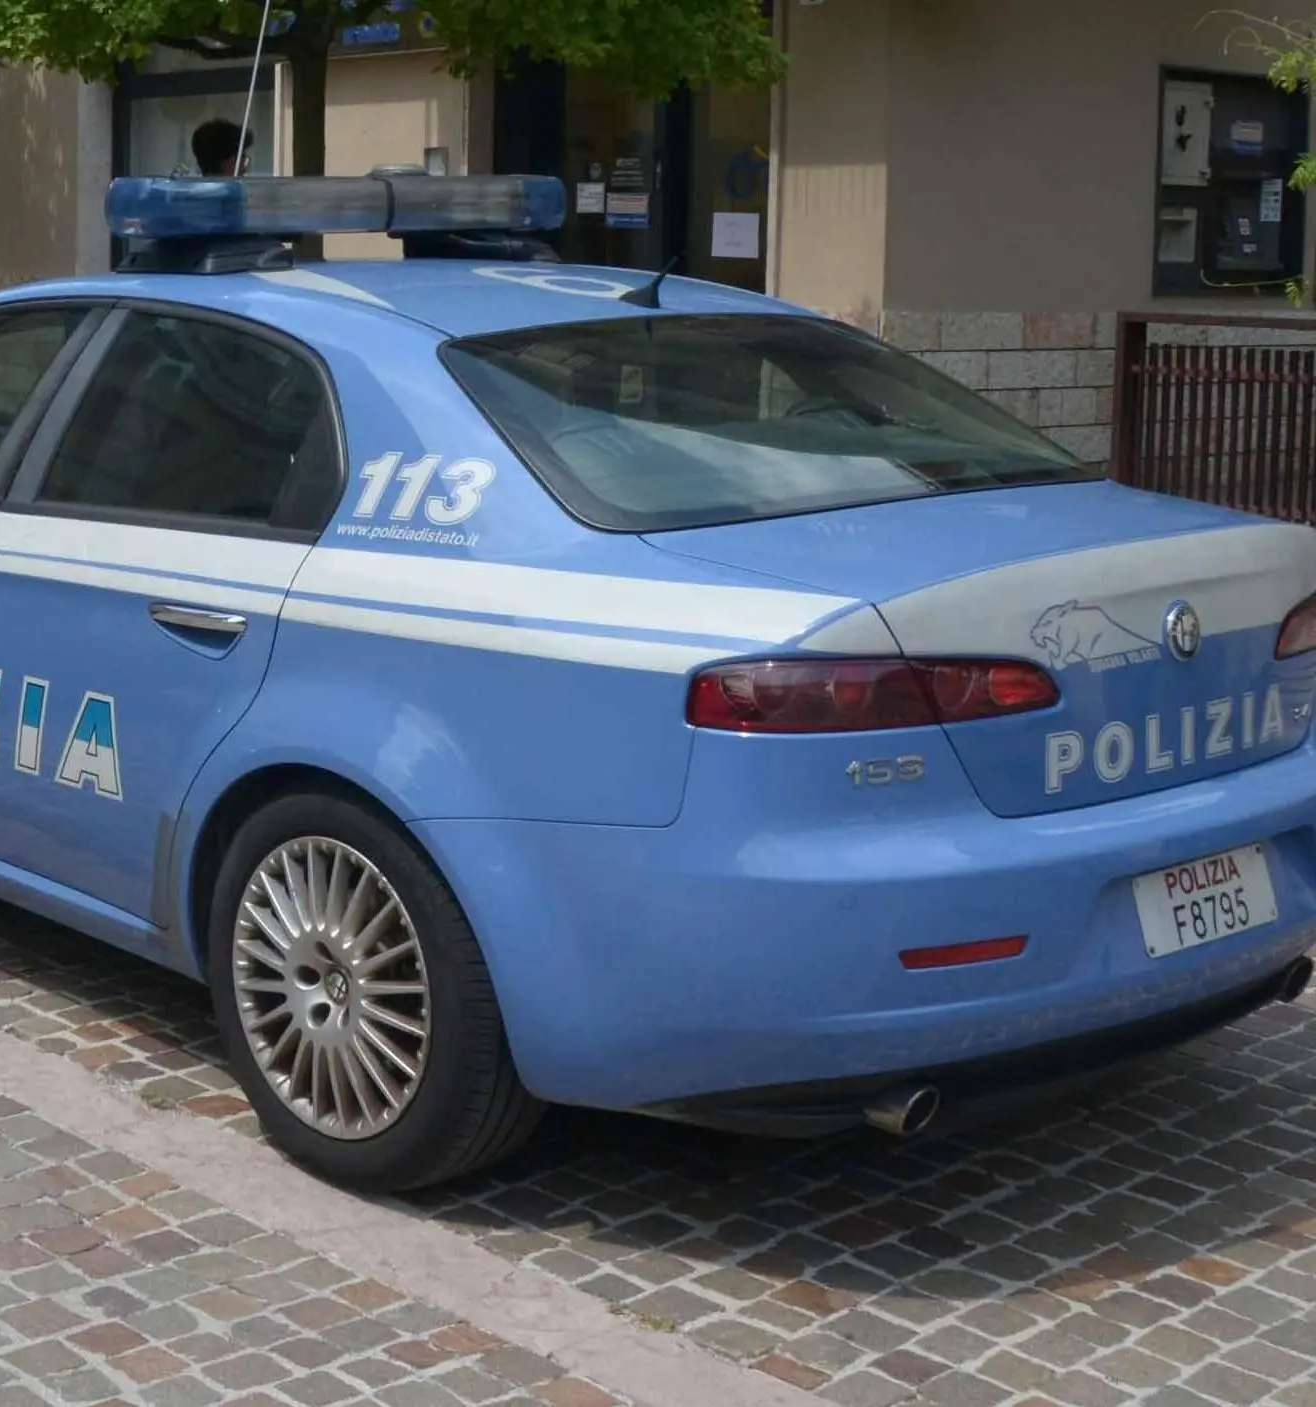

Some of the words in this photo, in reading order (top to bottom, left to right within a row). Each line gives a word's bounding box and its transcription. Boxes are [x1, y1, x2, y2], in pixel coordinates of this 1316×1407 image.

[352, 451, 497, 526] 113
[336, 522, 480, 548] www.poliziadistato.it
[1045, 683, 1284, 794] POLIZIA
[1165, 855, 1240, 899] POLIZIA
[1173, 886, 1250, 945] F8795
